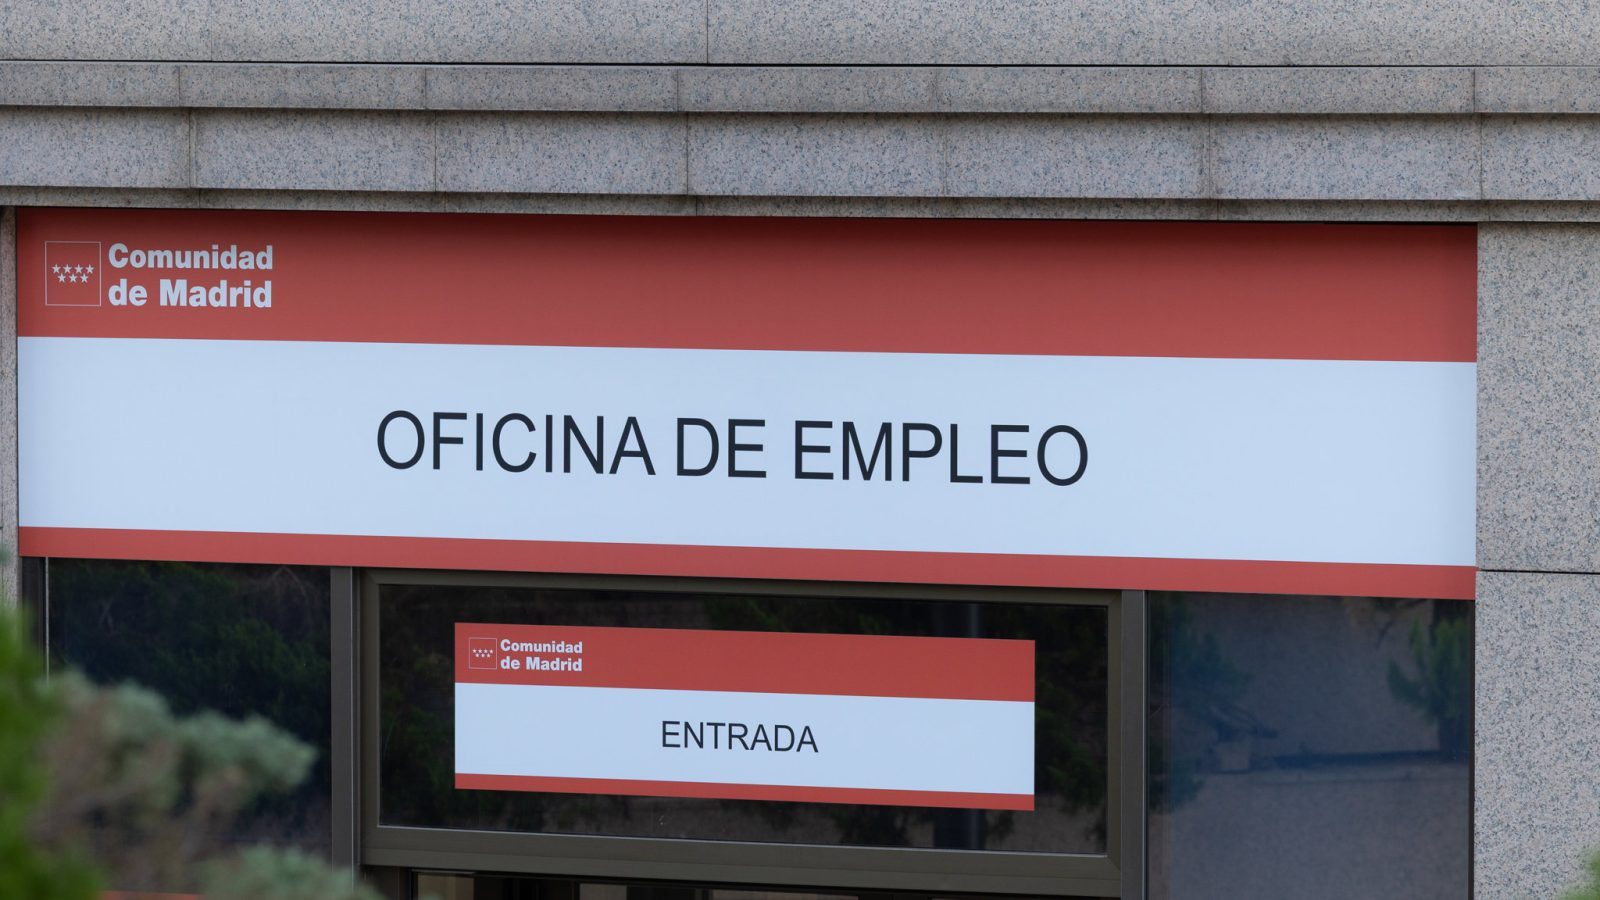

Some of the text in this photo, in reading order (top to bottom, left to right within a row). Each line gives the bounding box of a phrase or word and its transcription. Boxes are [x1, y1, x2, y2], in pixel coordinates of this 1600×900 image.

[108, 243, 273, 270] Comunidad
[108, 279, 272, 308] de Madrid
[377, 410, 1089, 487] OFICINA DE EMPLEO
[500, 639, 583, 654] Comunidad
[500, 656, 583, 672] de Madrid
[662, 720, 819, 753] ENTRADA
